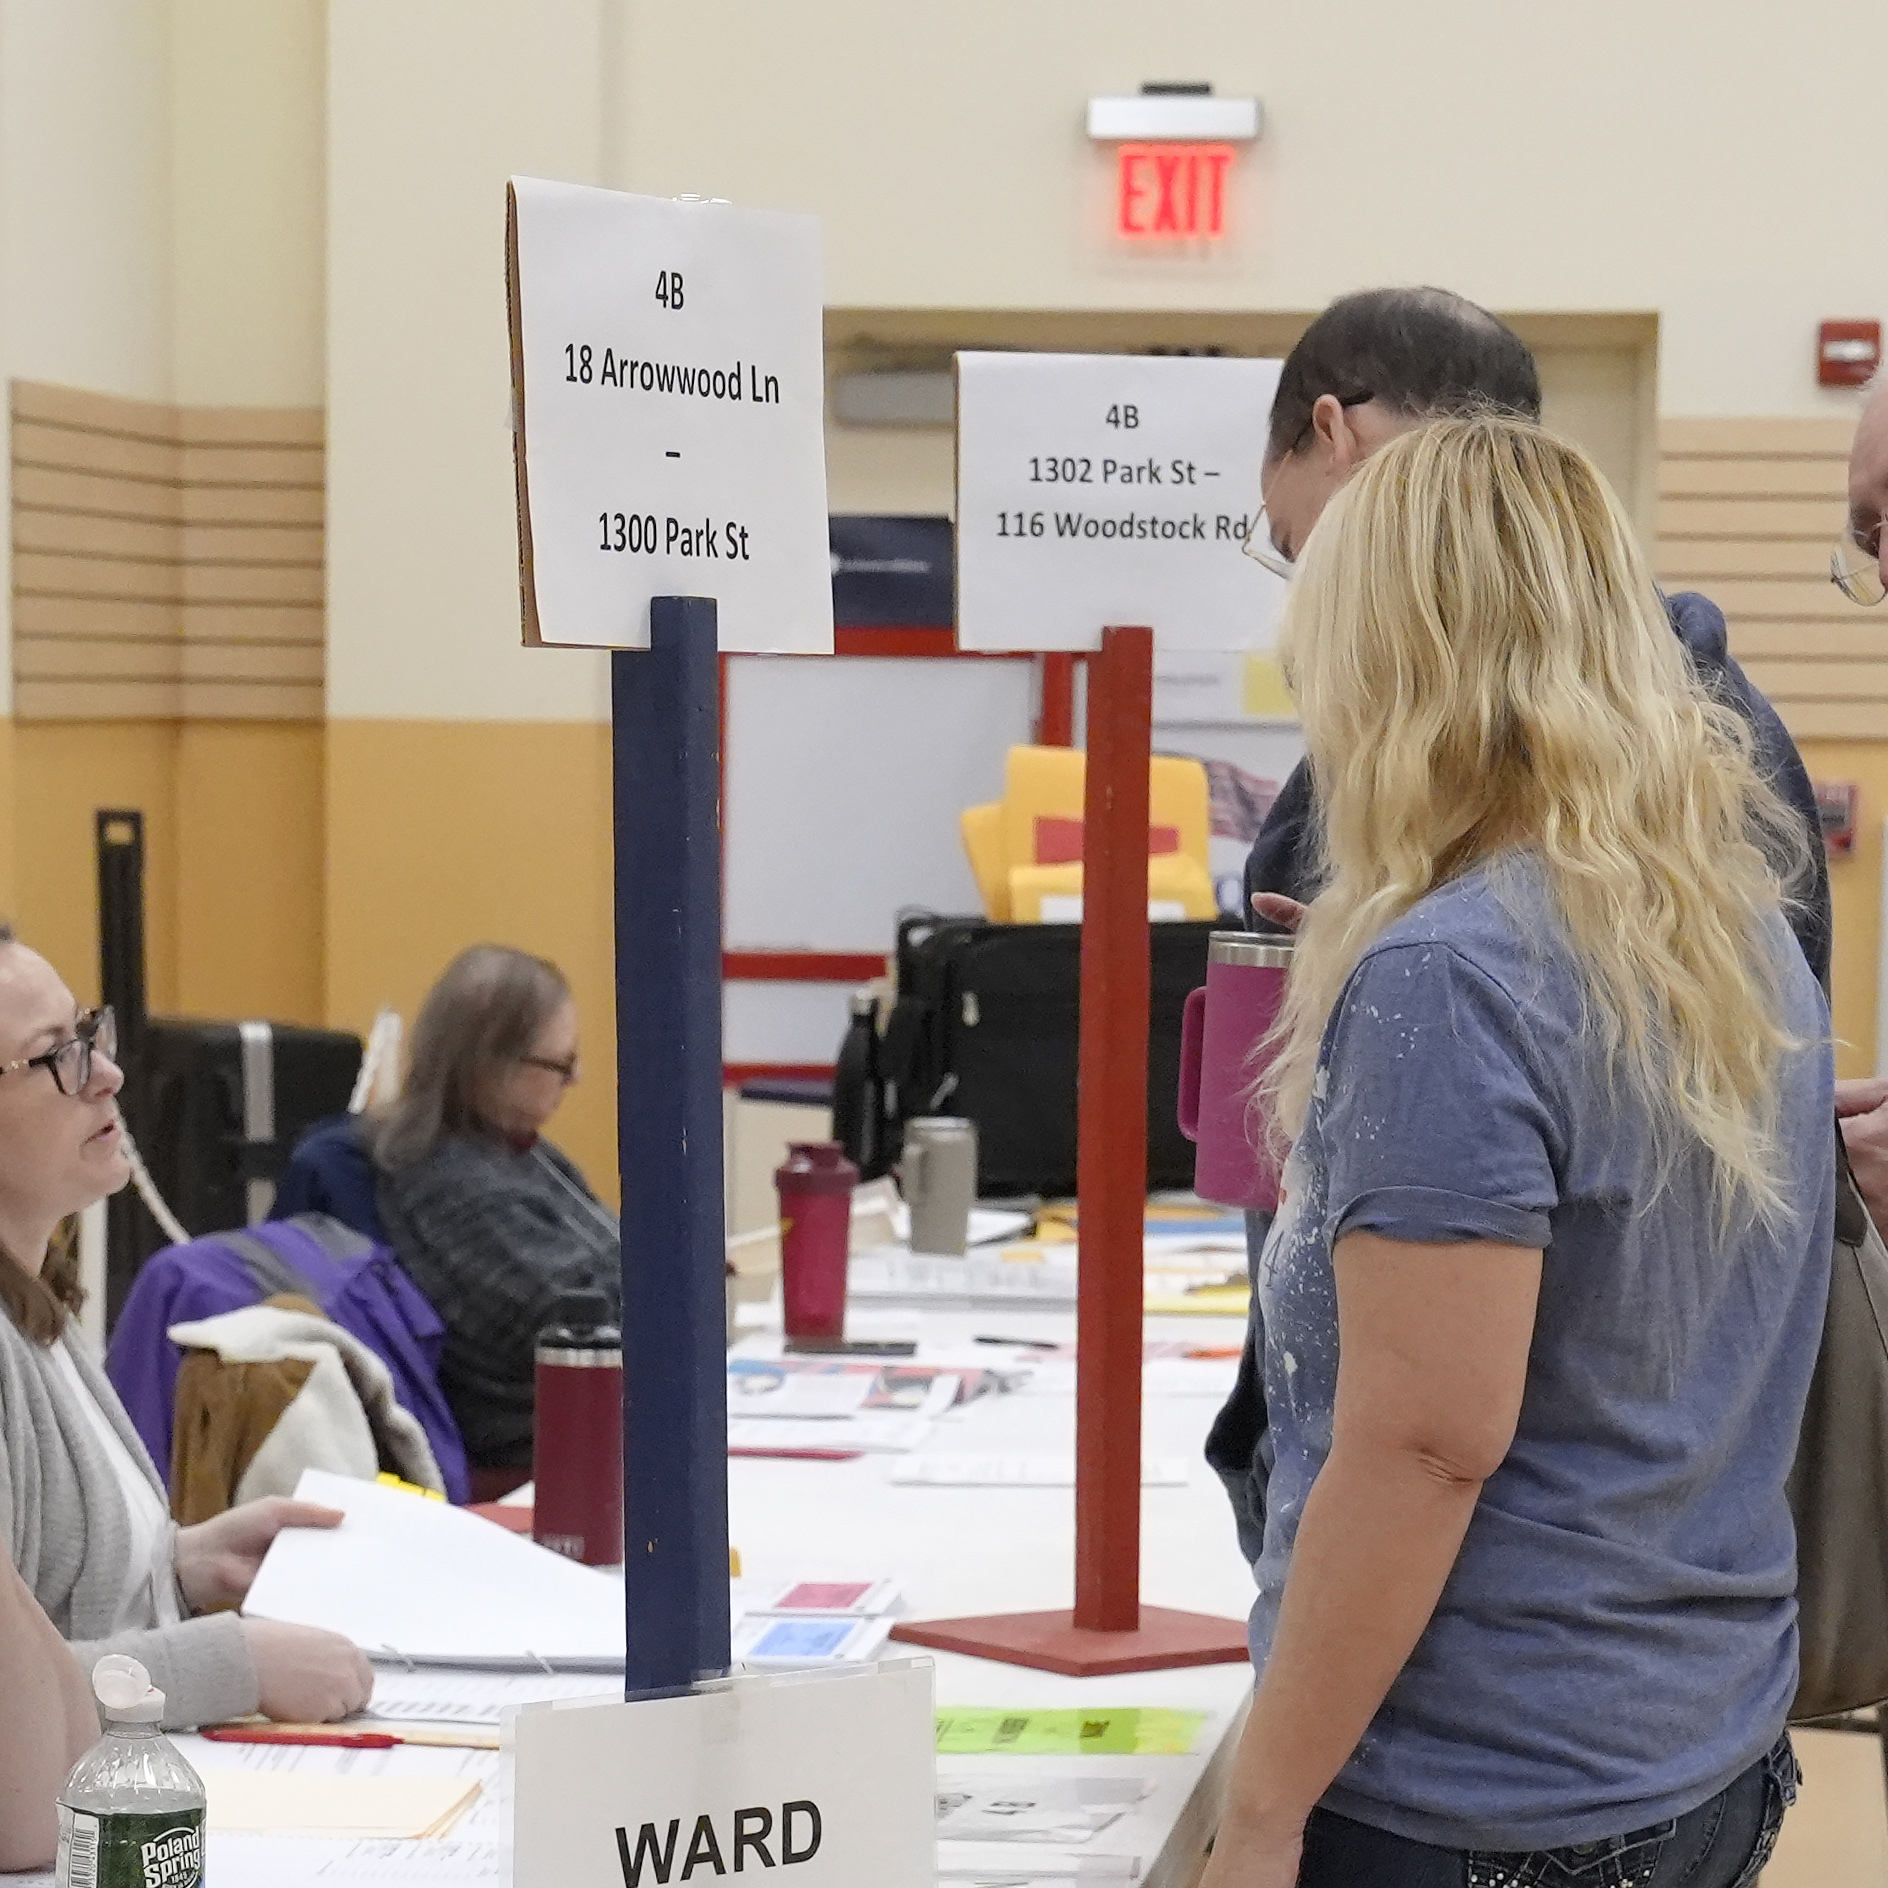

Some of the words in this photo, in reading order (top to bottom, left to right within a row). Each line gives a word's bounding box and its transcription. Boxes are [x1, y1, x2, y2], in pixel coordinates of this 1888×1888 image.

[1119, 150, 1231, 236] EXIT
[655, 271, 684, 309] 4B
[565, 343, 593, 384] 18
[601, 347, 742, 401] Arrowwood
[752, 365, 779, 404] Ln
[1105, 404, 1139, 429] 4B
[1029, 457, 1093, 483] 1302
[1103, 457, 1162, 484] Park
[1171, 459, 1196, 485] St
[599, 512, 657, 555] 1300
[666, 518, 718, 559] Park
[725, 521, 750, 561] St
[997, 511, 1045, 538] 116
[1054, 511, 1206, 539] Woodstock
[1216, 513, 1248, 540] Rd
[141, 1826, 200, 1868] Poland
[615, 1800, 822, 1888] WARD
